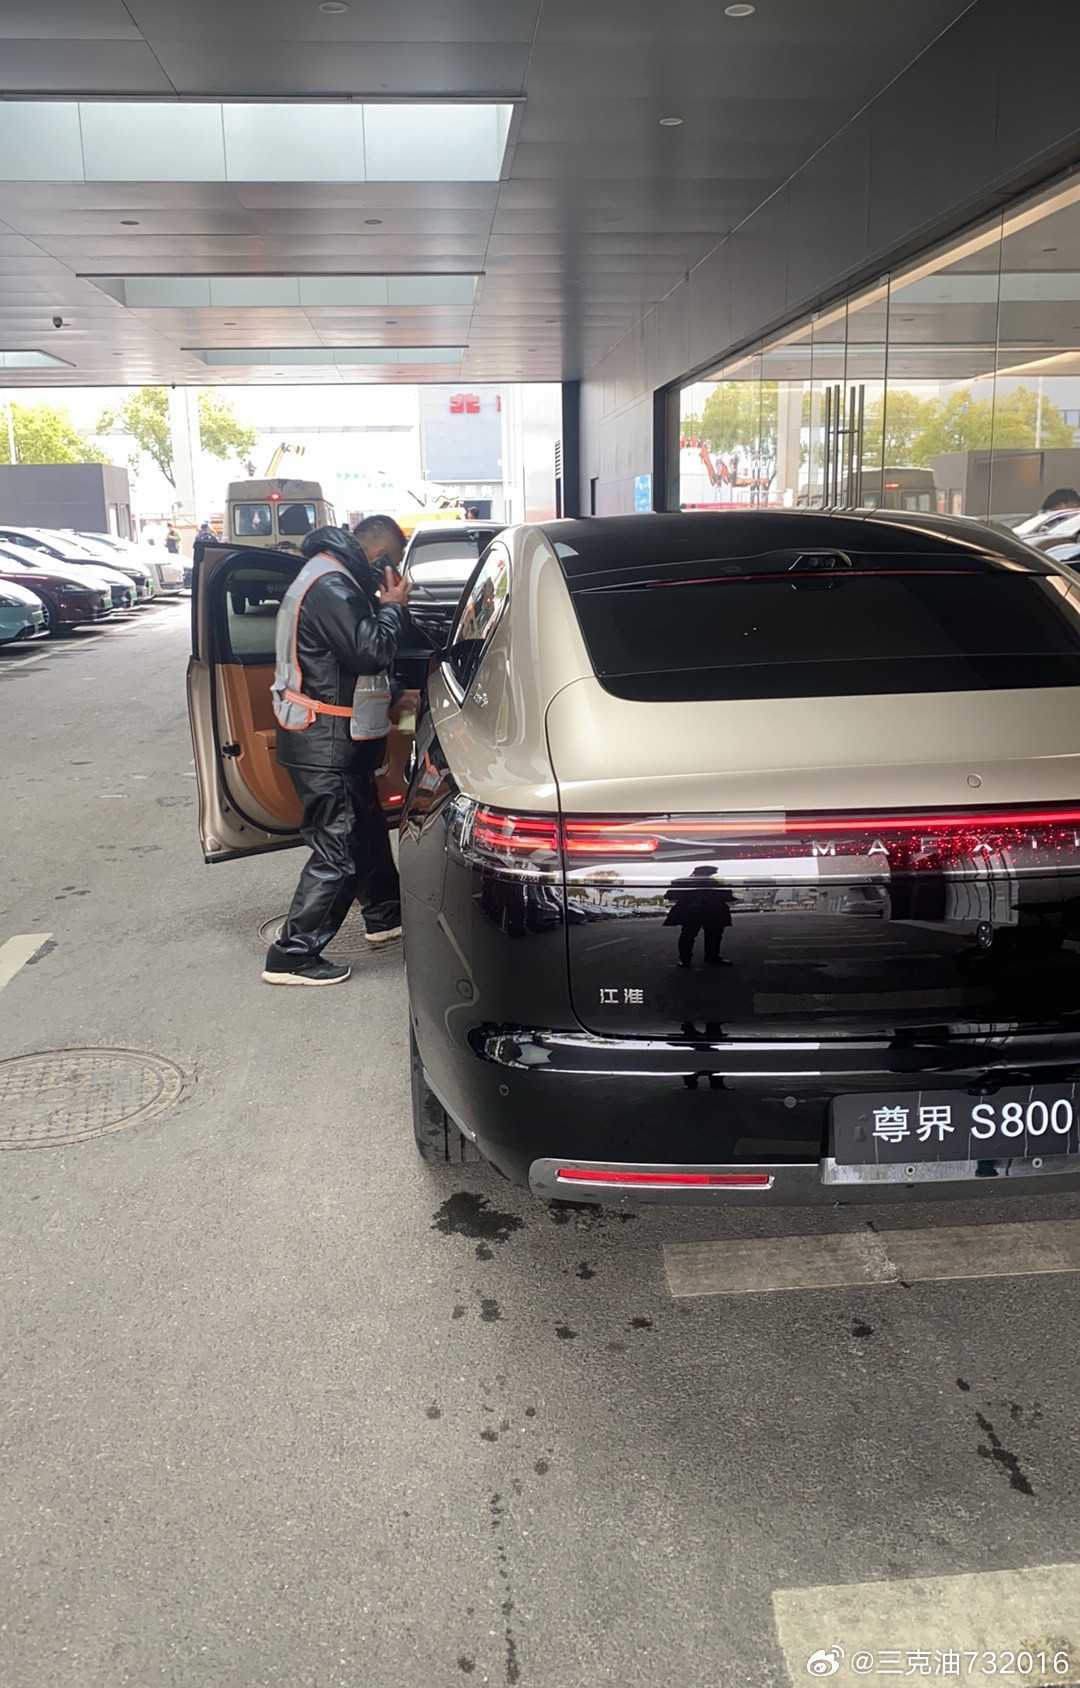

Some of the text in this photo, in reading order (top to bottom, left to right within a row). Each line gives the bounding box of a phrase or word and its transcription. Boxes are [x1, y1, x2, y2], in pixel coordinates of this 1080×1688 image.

[812, 831, 1080, 856] MAEXT
[599, 988, 644, 1004] 江淮
[872, 1099, 1074, 1143] 尊界 S800
